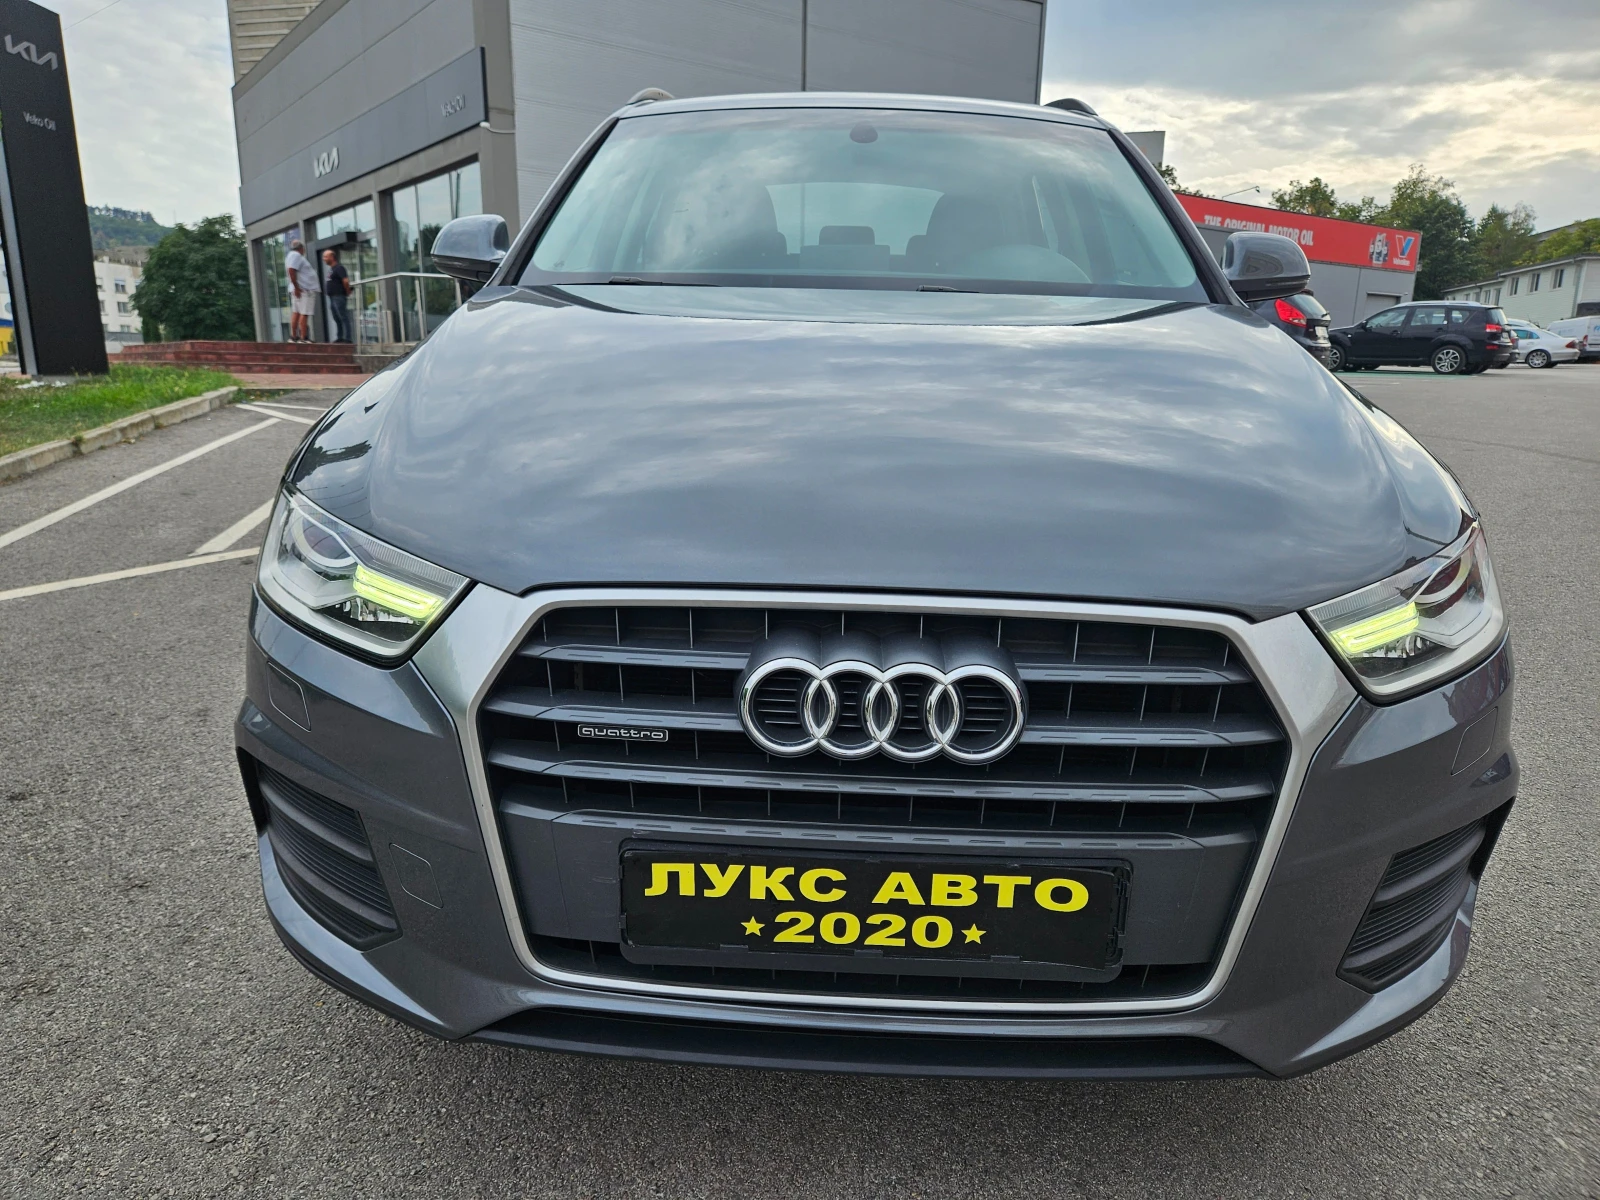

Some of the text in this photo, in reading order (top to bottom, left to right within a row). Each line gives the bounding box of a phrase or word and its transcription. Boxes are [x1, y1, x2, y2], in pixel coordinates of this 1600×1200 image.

[1204, 215, 1221, 226] THE
[1224, 218, 1265, 232] ORIGINAL
[1301, 230, 1313, 246] OIL
[582, 727, 664, 739] quattro
[644, 862, 1090, 913] ЛУКС АВТО
[773, 911, 954, 949] 2020
